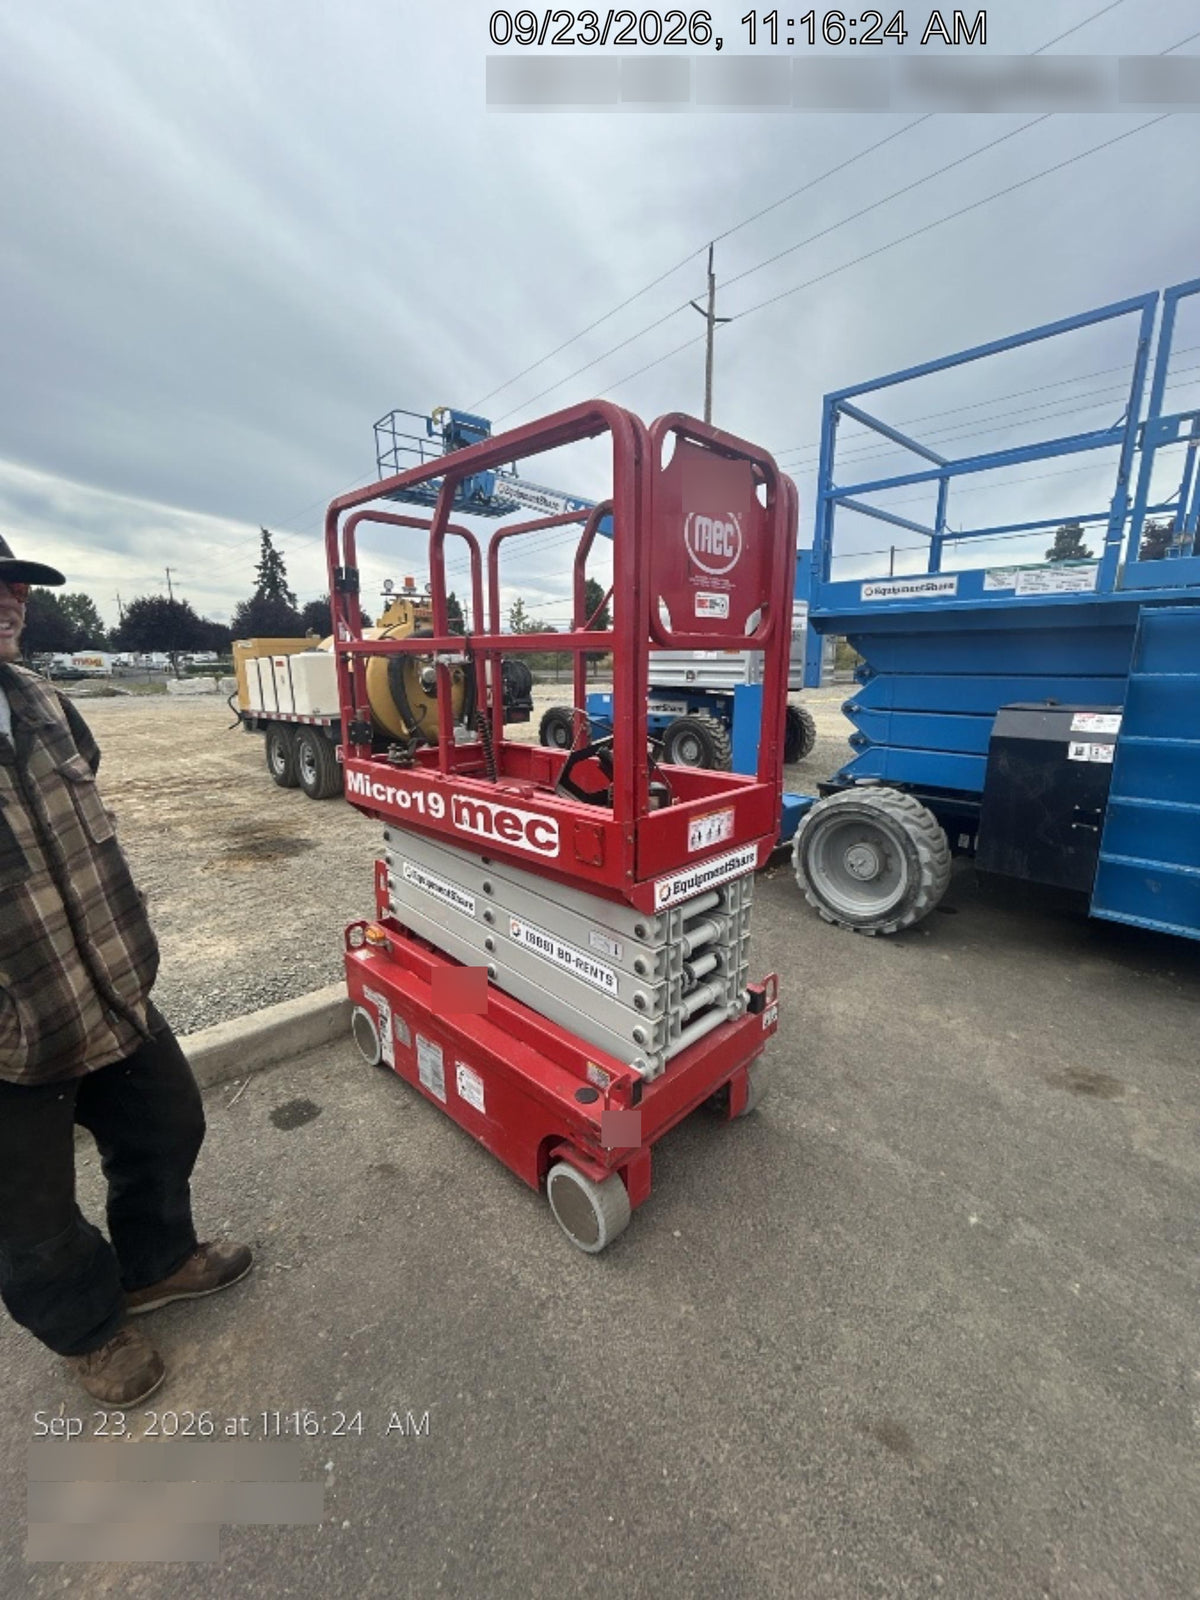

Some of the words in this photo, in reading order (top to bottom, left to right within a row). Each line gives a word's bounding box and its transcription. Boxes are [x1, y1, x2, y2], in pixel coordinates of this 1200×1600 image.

[346, 769, 446, 819] Micro19
[453, 799, 558, 852] mec
[672, 853, 755, 895] EquipmentShare
